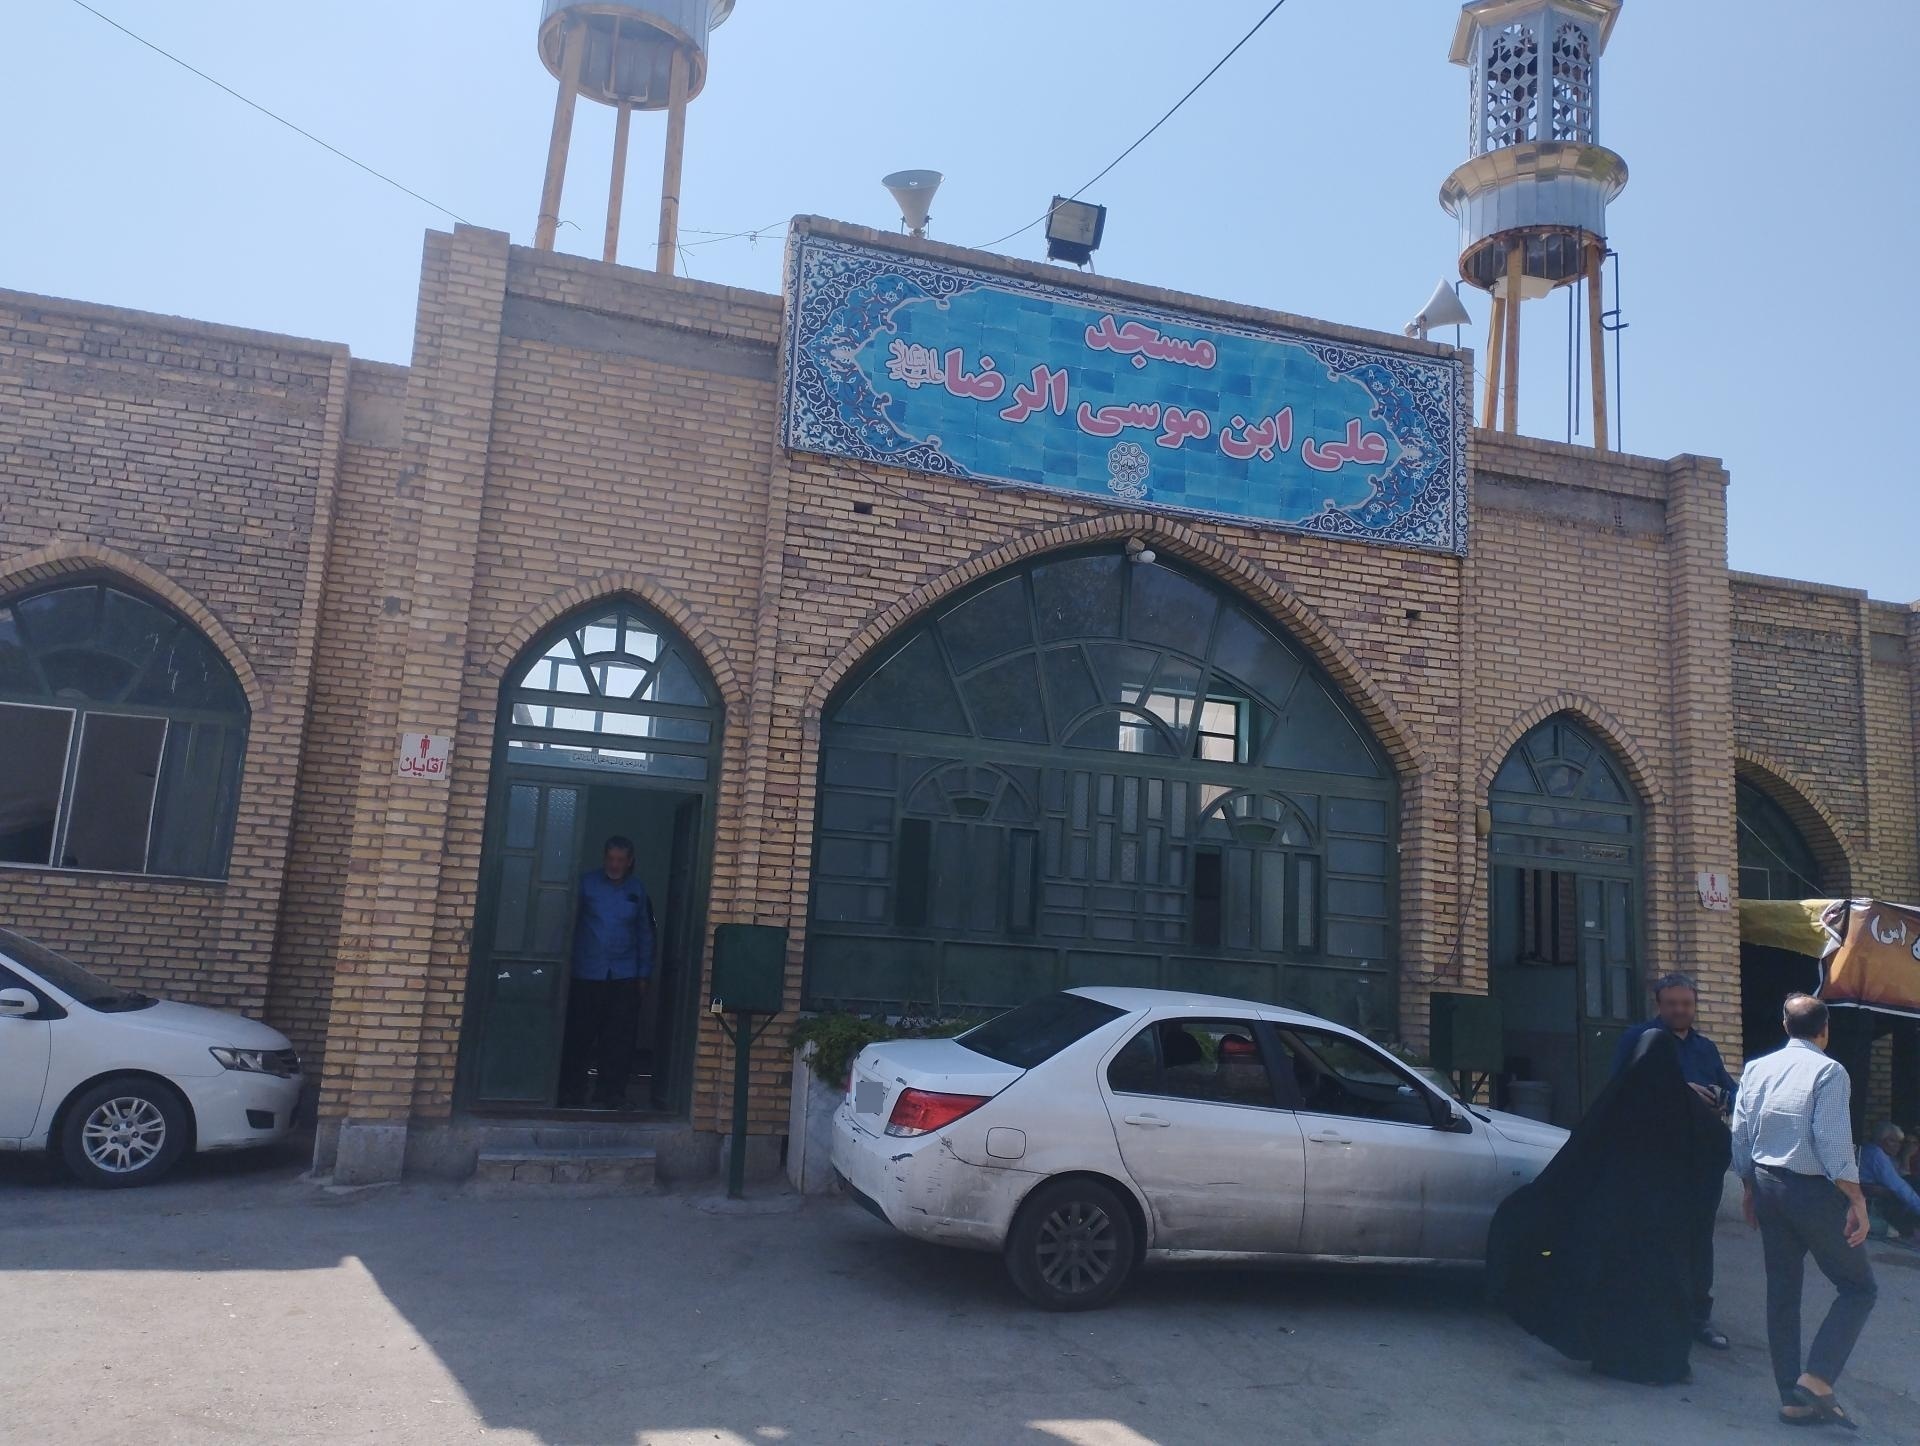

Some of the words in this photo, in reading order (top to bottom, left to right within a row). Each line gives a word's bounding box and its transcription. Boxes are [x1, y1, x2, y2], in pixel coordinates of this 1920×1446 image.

[1086, 314, 1216, 371] مسجد
[944, 349, 1068, 423] الرضا
[1078, 398, 1210, 448] موسی
[1220, 407, 1293, 461] ابن
[1302, 419, 1387, 471] علی
[400, 757, 446, 777] آقایان
